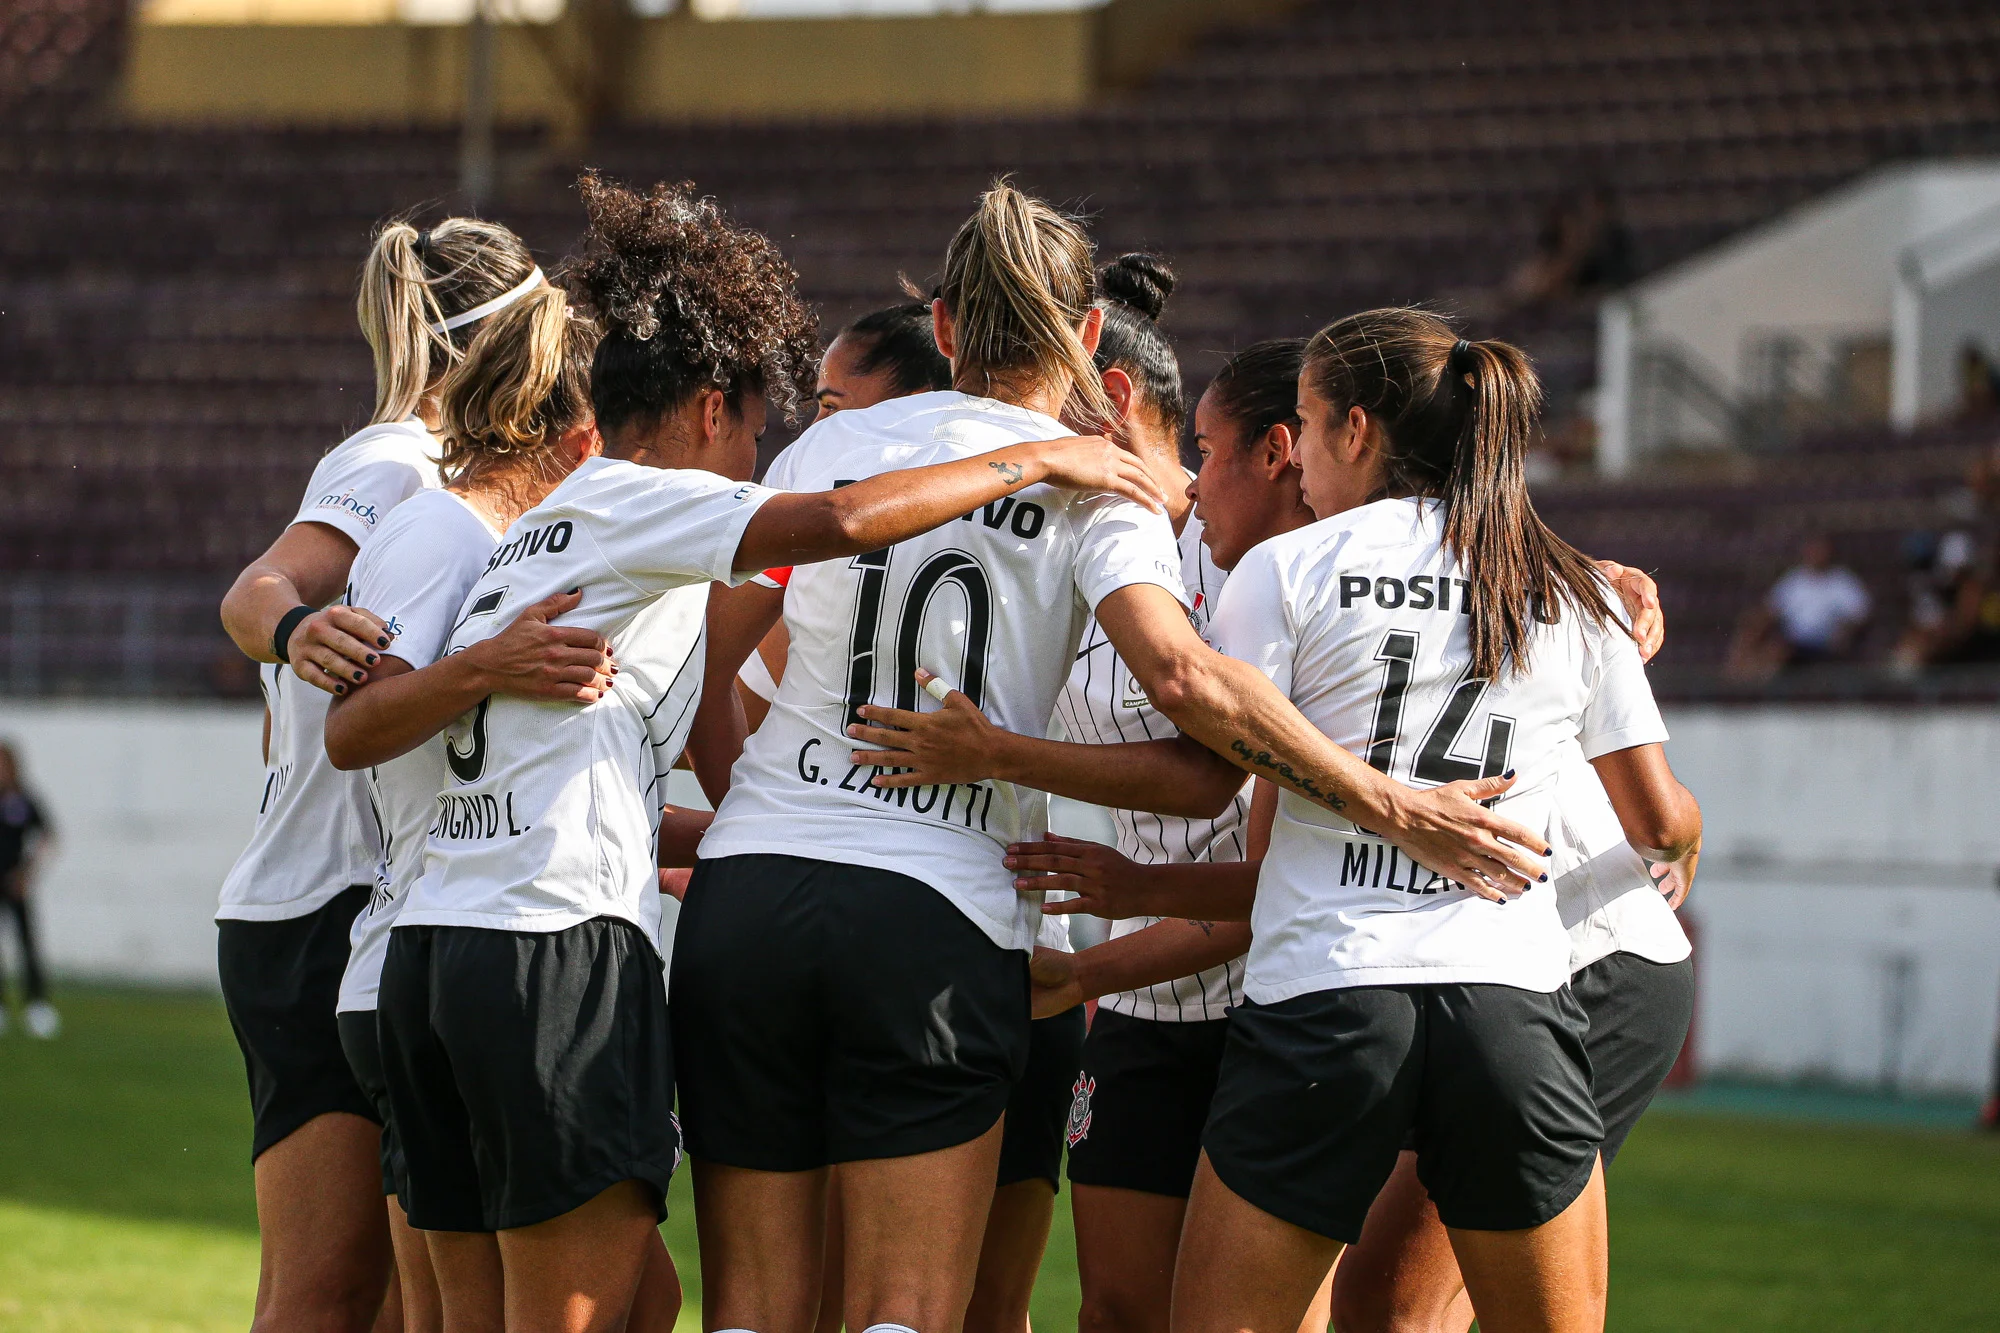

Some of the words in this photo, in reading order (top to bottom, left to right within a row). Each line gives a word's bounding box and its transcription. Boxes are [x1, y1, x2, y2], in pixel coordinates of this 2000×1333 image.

[319, 488, 379, 525] minds
[344, 509, 372, 531] SCHOOL
[481, 521, 573, 580] SITIVO
[842, 545, 994, 738] 10
[1353, 628, 1517, 838] 14
[797, 737, 828, 786] G.
[428, 793, 499, 839] NGRYD
[506, 791, 531, 837] L.
[1339, 841, 1466, 896] MILL
